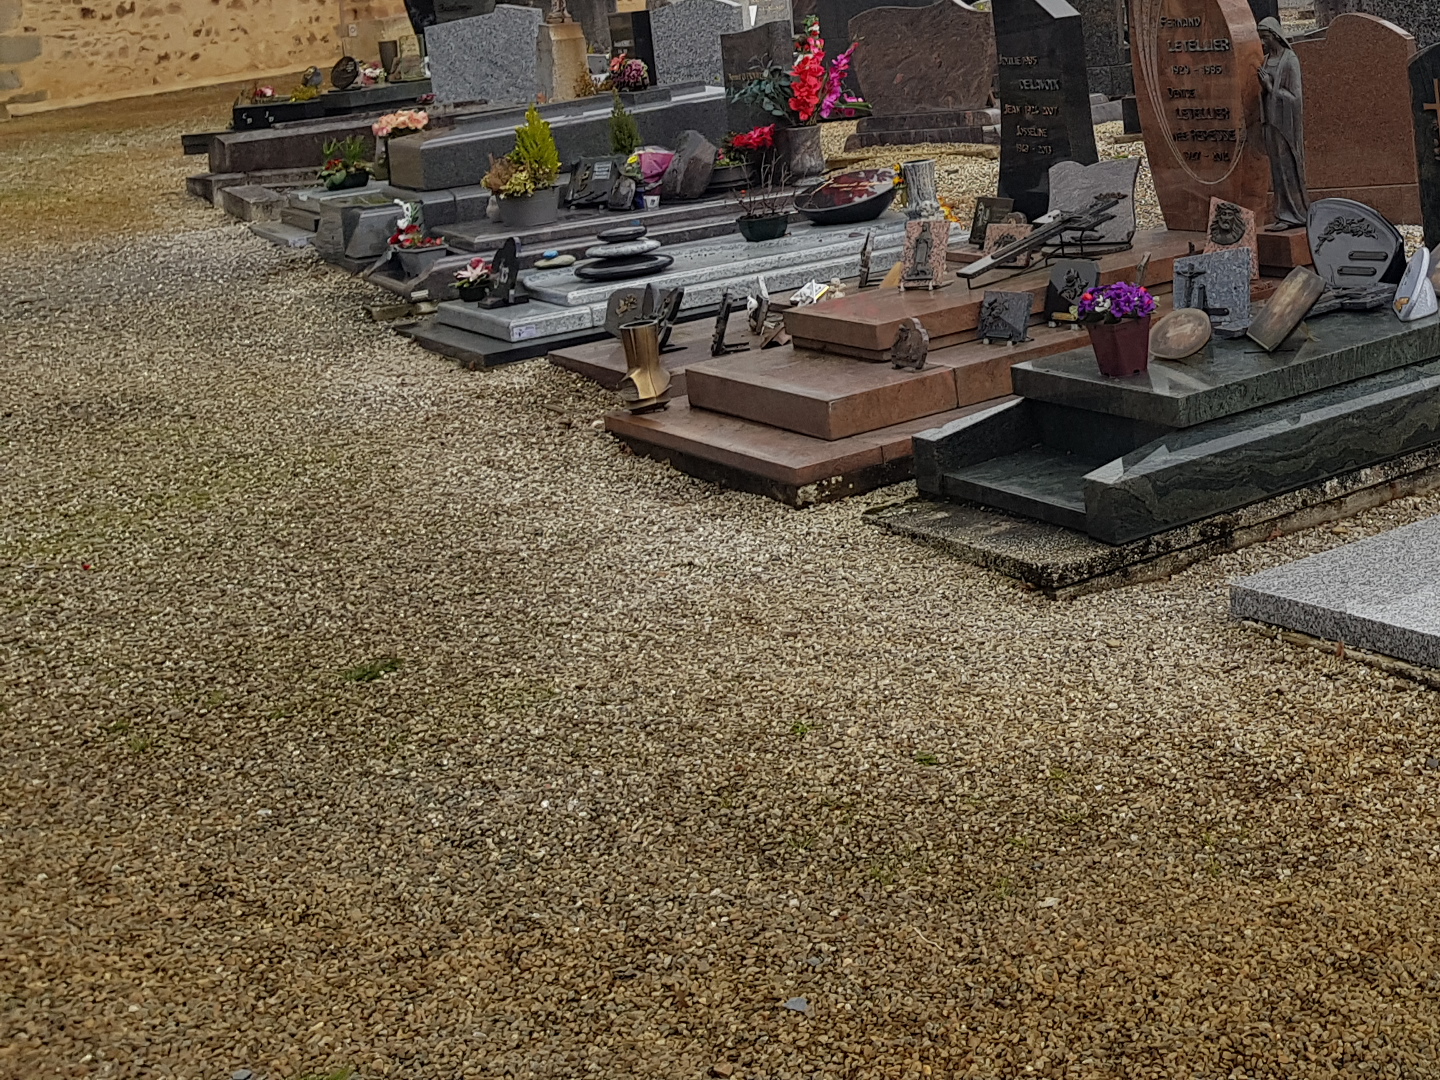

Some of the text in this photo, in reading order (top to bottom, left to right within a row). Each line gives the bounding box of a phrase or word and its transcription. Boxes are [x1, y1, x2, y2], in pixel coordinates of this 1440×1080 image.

[1160, 16, 1201, 29] FERNAND
[1167, 38, 1230, 52] LETELLIER
[1003, 103, 1020, 115] JEAN
[1175, 107, 1230, 121] LETELLIER
